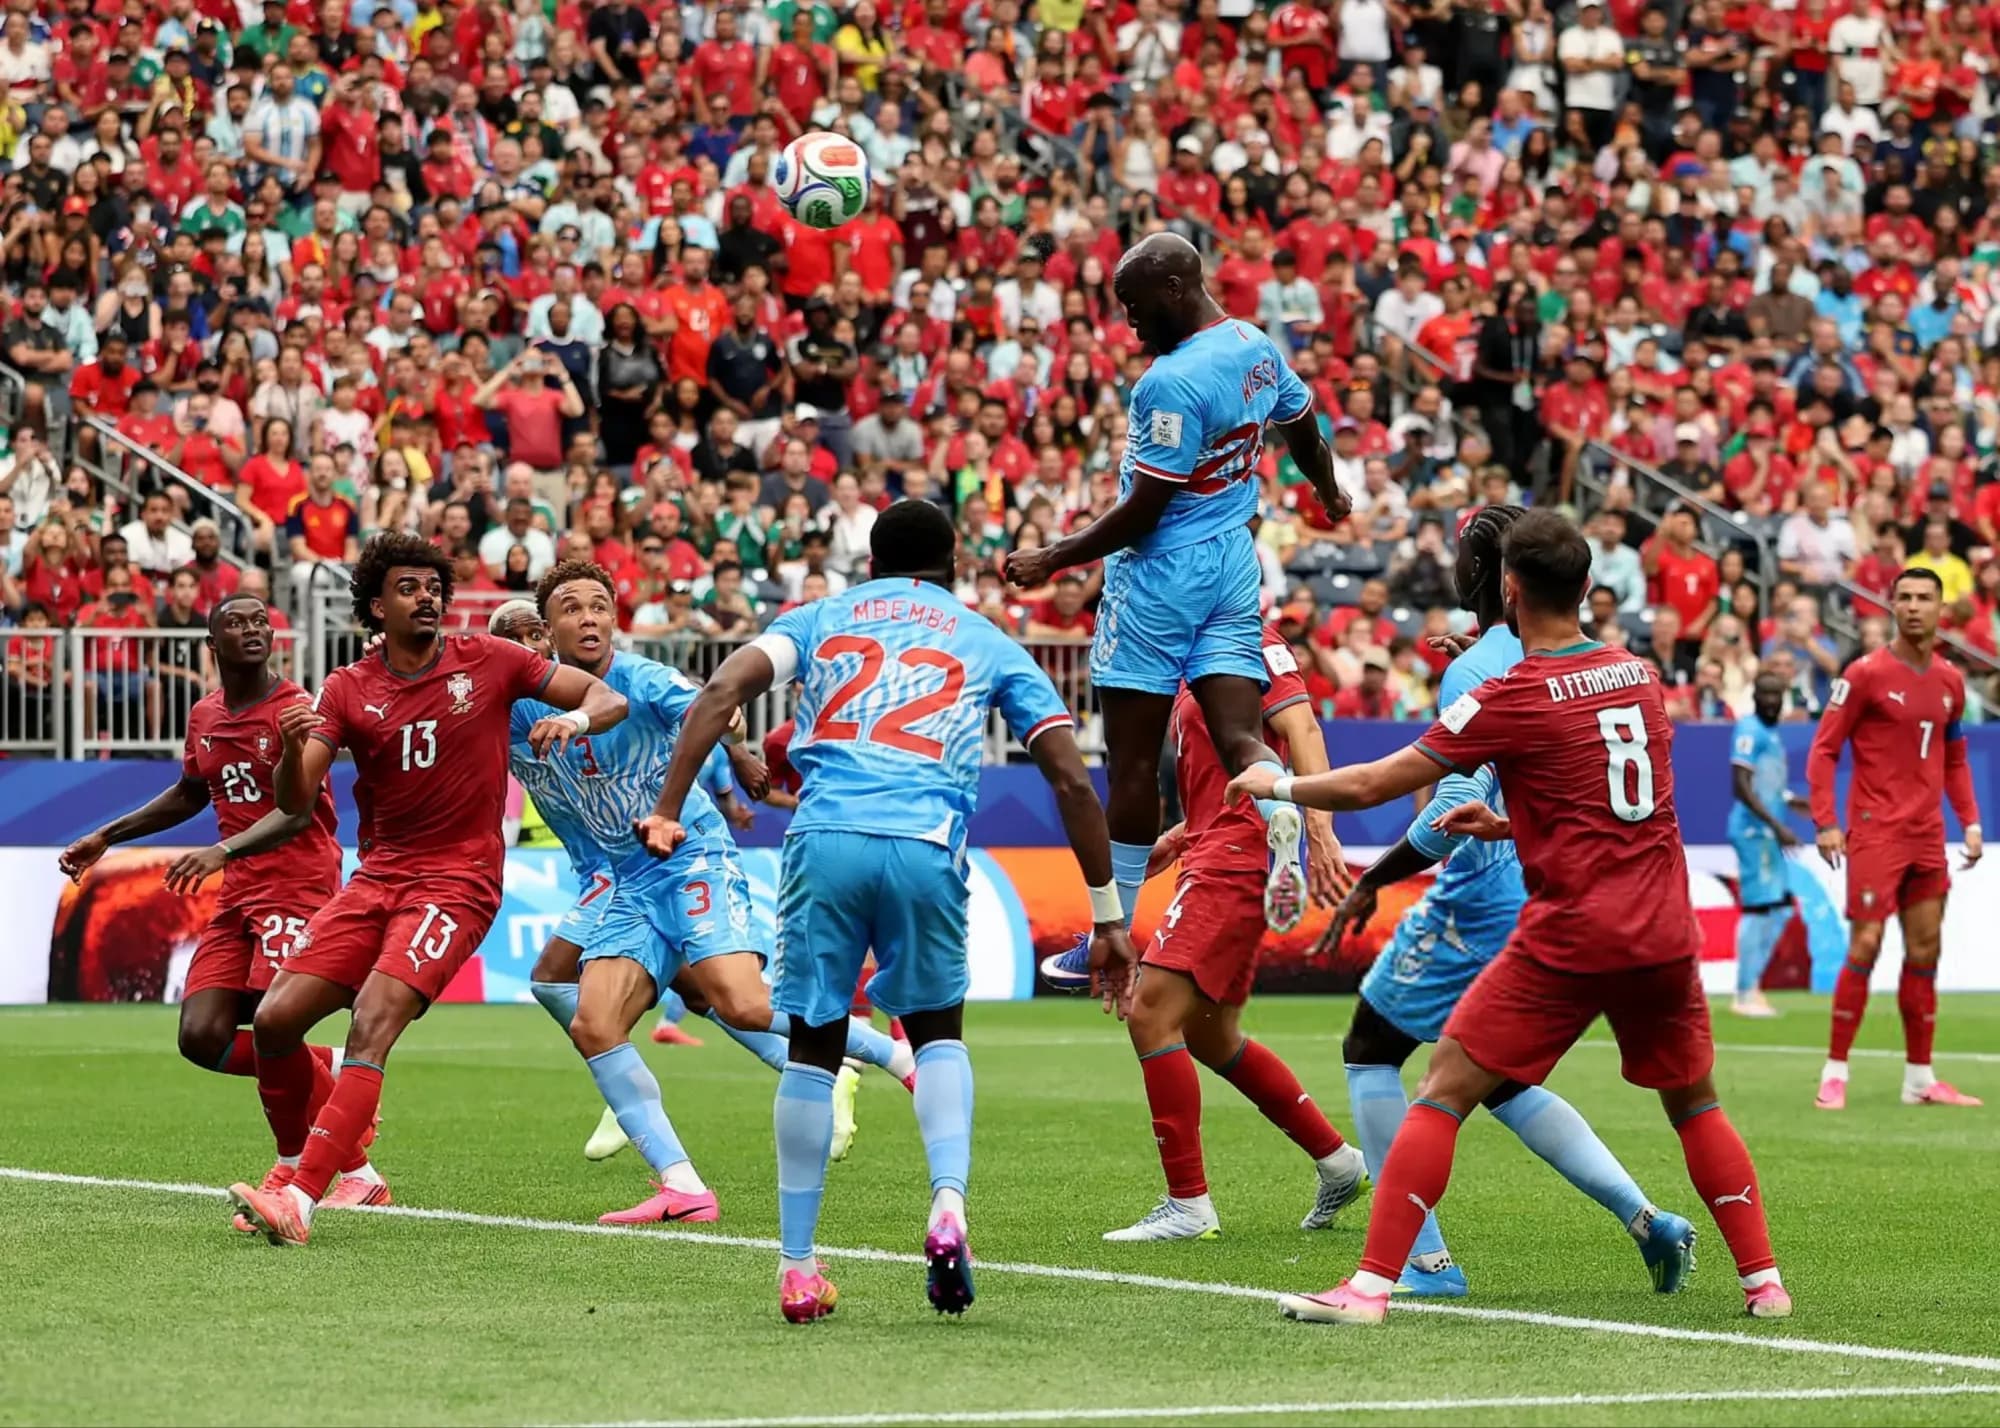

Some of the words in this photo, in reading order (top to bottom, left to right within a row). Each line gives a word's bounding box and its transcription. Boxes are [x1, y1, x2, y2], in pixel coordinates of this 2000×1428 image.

[853, 600, 958, 635] MBEMBA
[808, 635, 966, 762] 22
[400, 719, 438, 772] 13
[575, 737, 599, 777] 3
[1919, 720, 1934, 760] 7
[221, 761, 262, 804] 25
[1596, 703, 1656, 822] 8
[577, 872, 613, 907] 7
[684, 880, 711, 917] 3
[1164, 881, 1193, 930] 4
[261, 914, 306, 959] 25
[410, 903, 459, 960] 13
